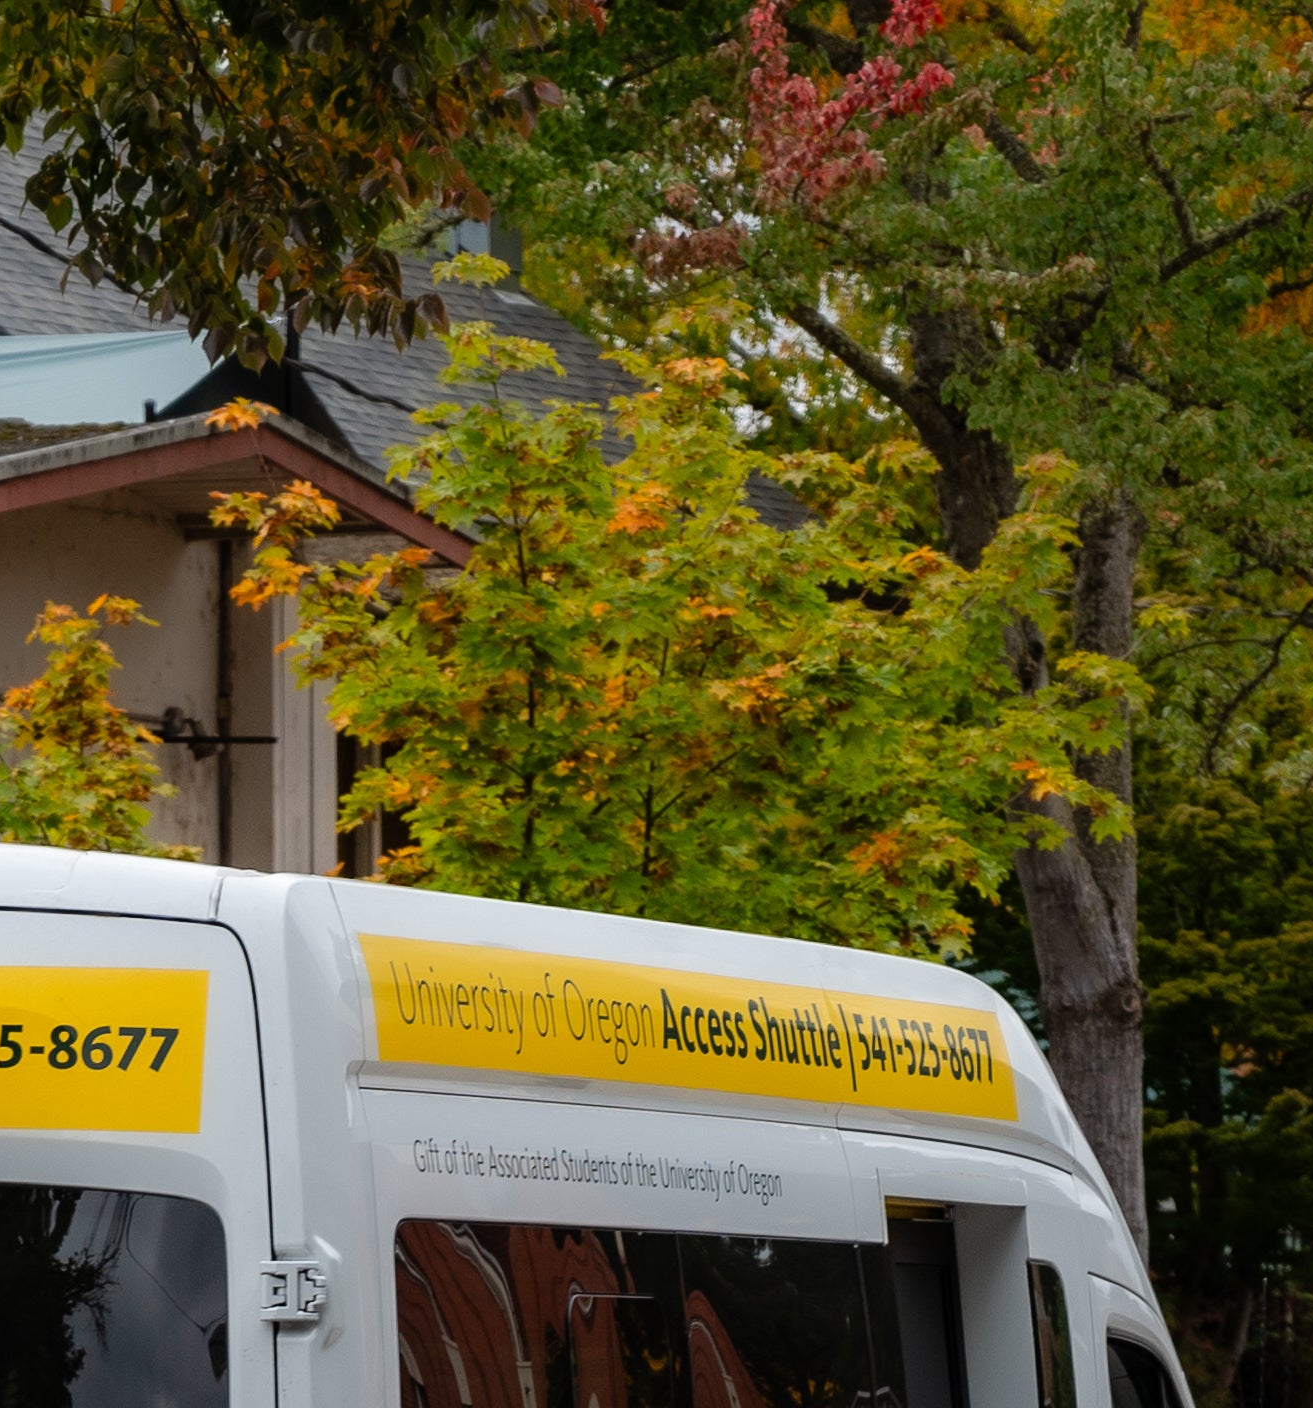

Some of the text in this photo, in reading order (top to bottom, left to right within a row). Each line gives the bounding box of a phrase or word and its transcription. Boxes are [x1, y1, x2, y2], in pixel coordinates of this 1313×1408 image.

[390, 960, 993, 1085] University of Oregon Access Shuttle 541-525-8677
[413, 1138, 783, 1206] Gift of the Associated Students of the University of Oregon
